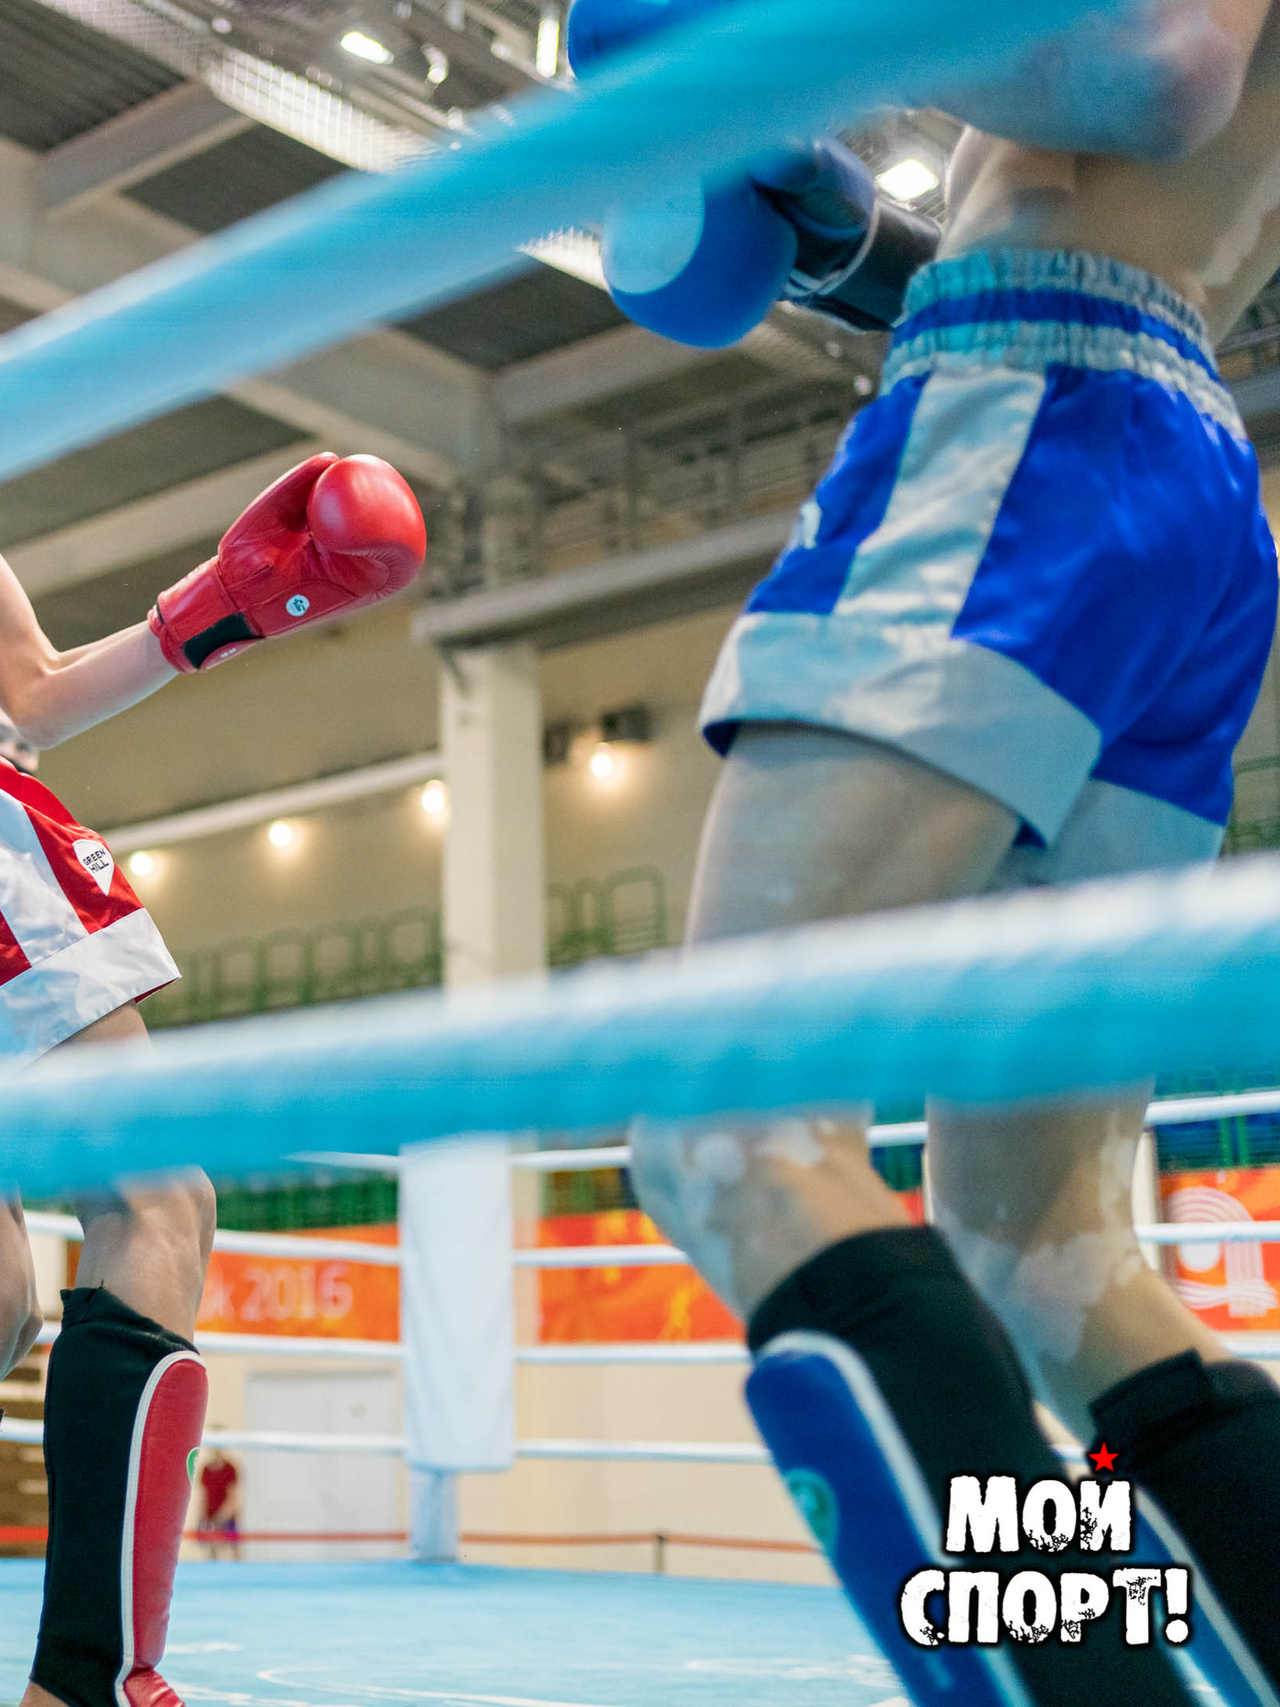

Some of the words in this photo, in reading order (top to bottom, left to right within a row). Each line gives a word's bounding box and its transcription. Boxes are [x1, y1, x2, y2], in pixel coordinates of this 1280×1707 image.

[82, 848, 106, 866] GREEN
[88, 859, 110, 874] HILL
[239, 1260, 354, 1322] 2016
